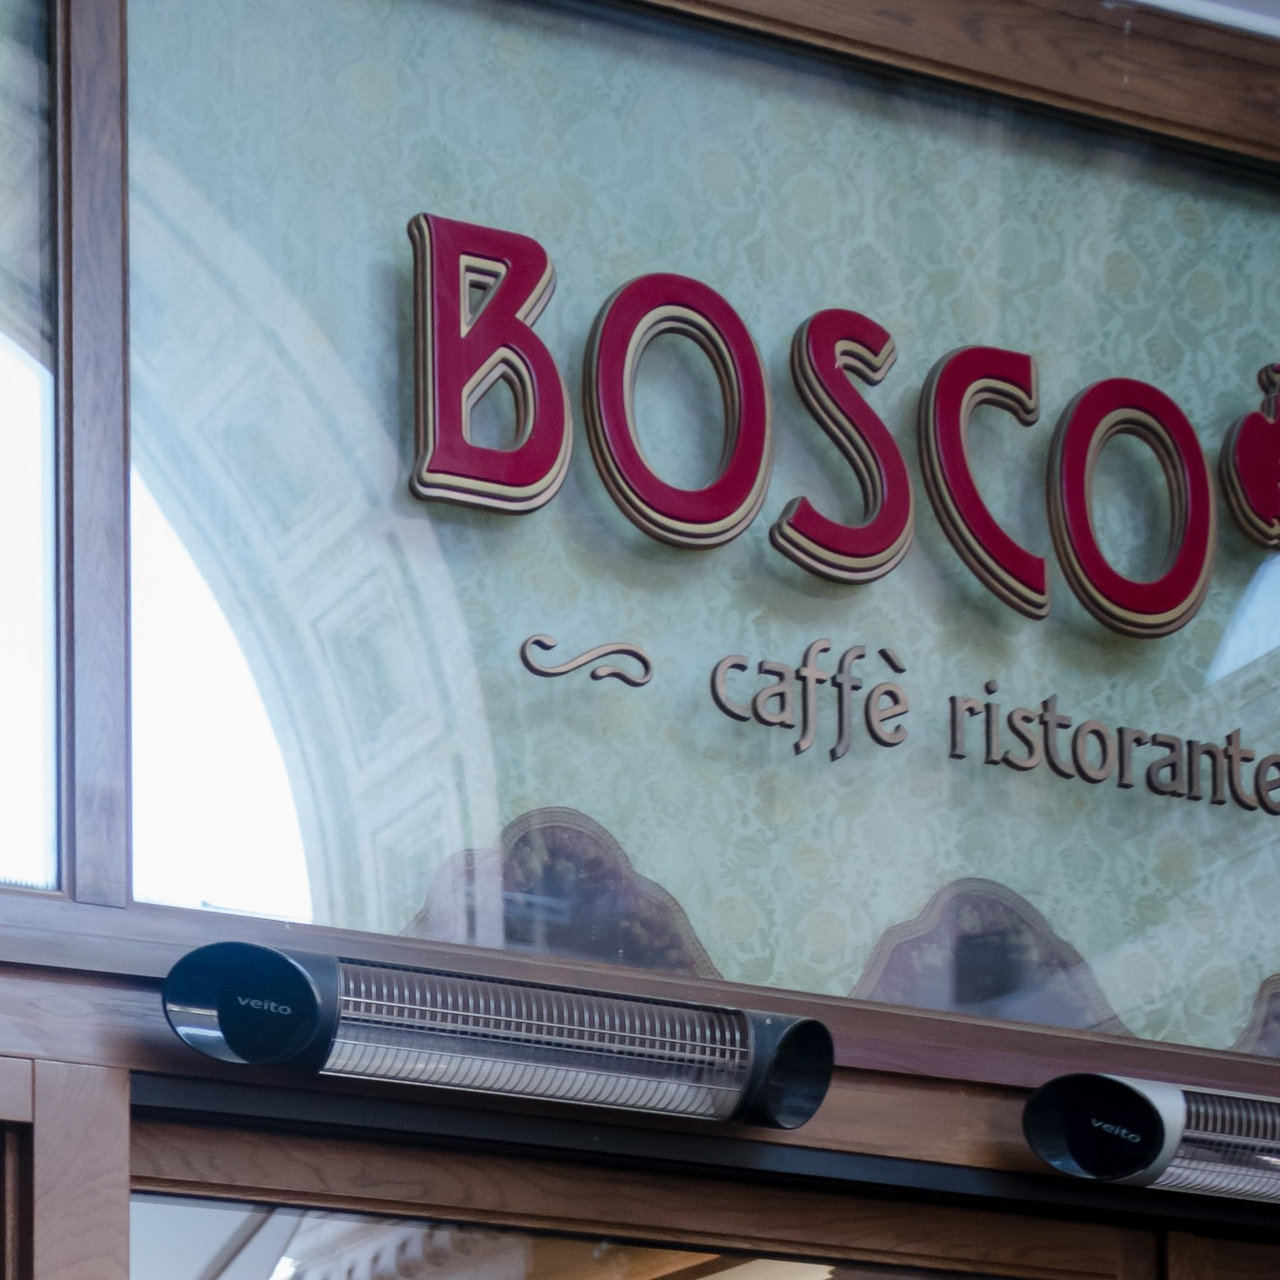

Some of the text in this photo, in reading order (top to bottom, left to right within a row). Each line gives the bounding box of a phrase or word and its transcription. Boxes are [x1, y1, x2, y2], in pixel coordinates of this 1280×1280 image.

[408, 212, 1216, 640] BOSCO
[710, 638, 1280, 816] caffè ristorante
[237, 996, 292, 1015] veito
[1091, 1118, 1141, 1143] veito
